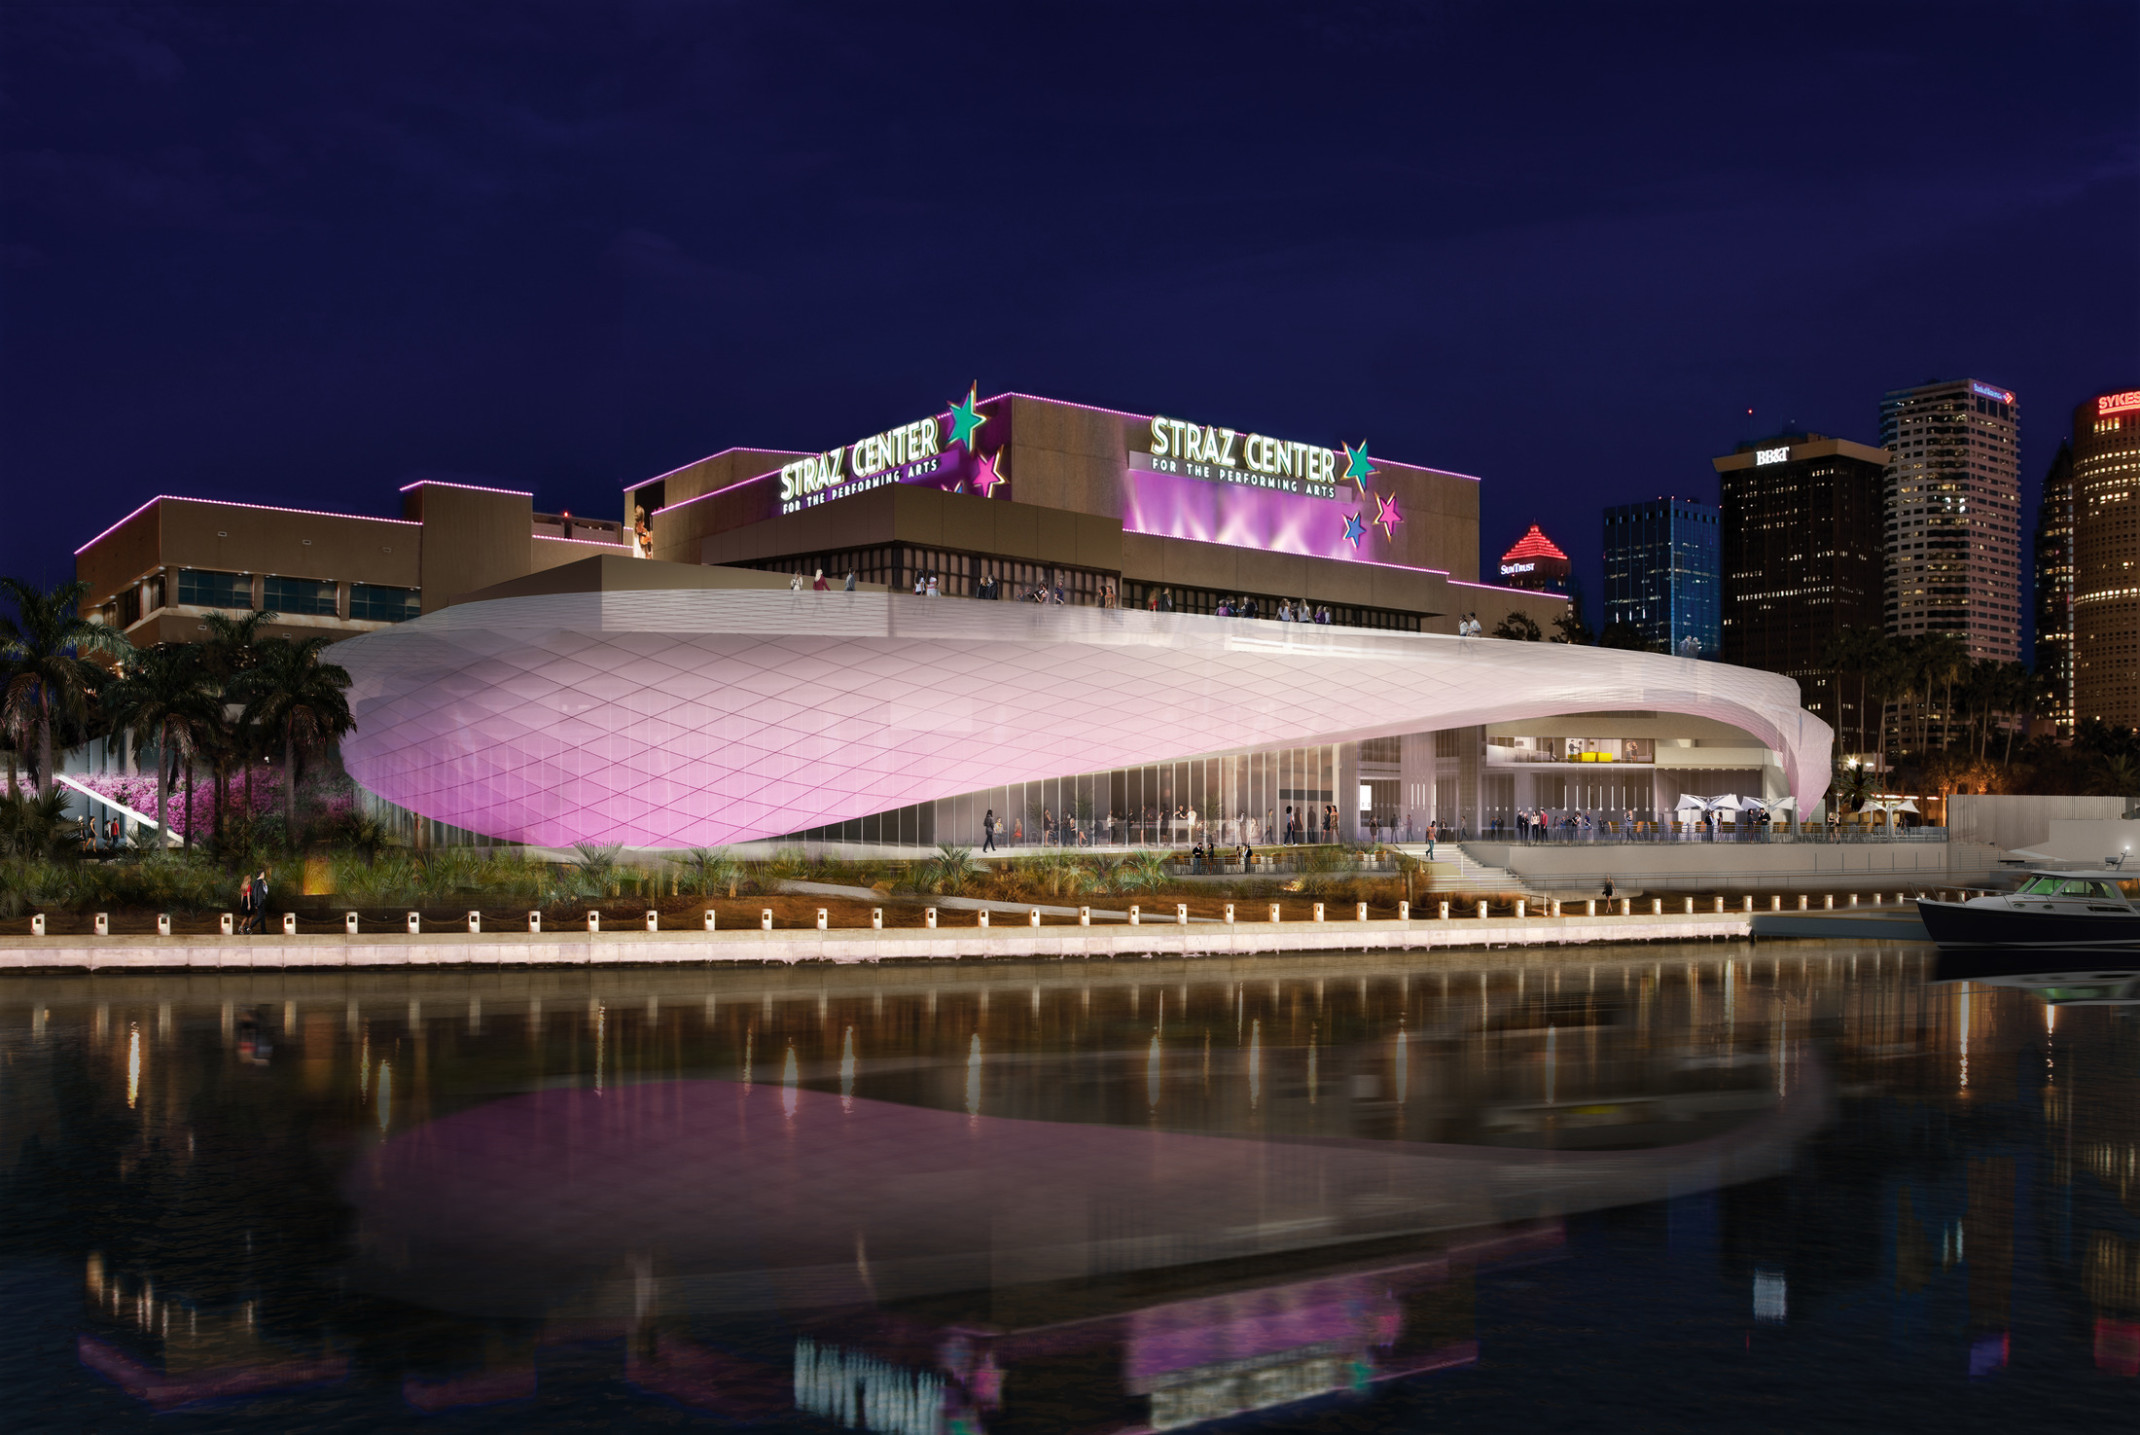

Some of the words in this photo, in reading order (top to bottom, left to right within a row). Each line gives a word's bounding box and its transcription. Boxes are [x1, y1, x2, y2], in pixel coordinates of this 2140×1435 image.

[2099, 391, 2140, 409] SYKES
[780, 446, 845, 500] STRAZ
[852, 417, 939, 478] CENTER
[1151, 415, 1236, 468] STRAZ
[1244, 433, 1336, 484] CENTER
[1756, 446, 1790, 466] BB&T
[783, 502, 801, 515] FOR
[807, 493, 825, 508] THE
[832, 471, 900, 500] PERFORMING
[907, 459, 938, 478] ARTS
[1152, 458, 1177, 473] FOR
[1187, 464, 1210, 478] THE
[1219, 469, 1298, 492] PERFORMING
[1305, 484, 1335, 498] ARTS
